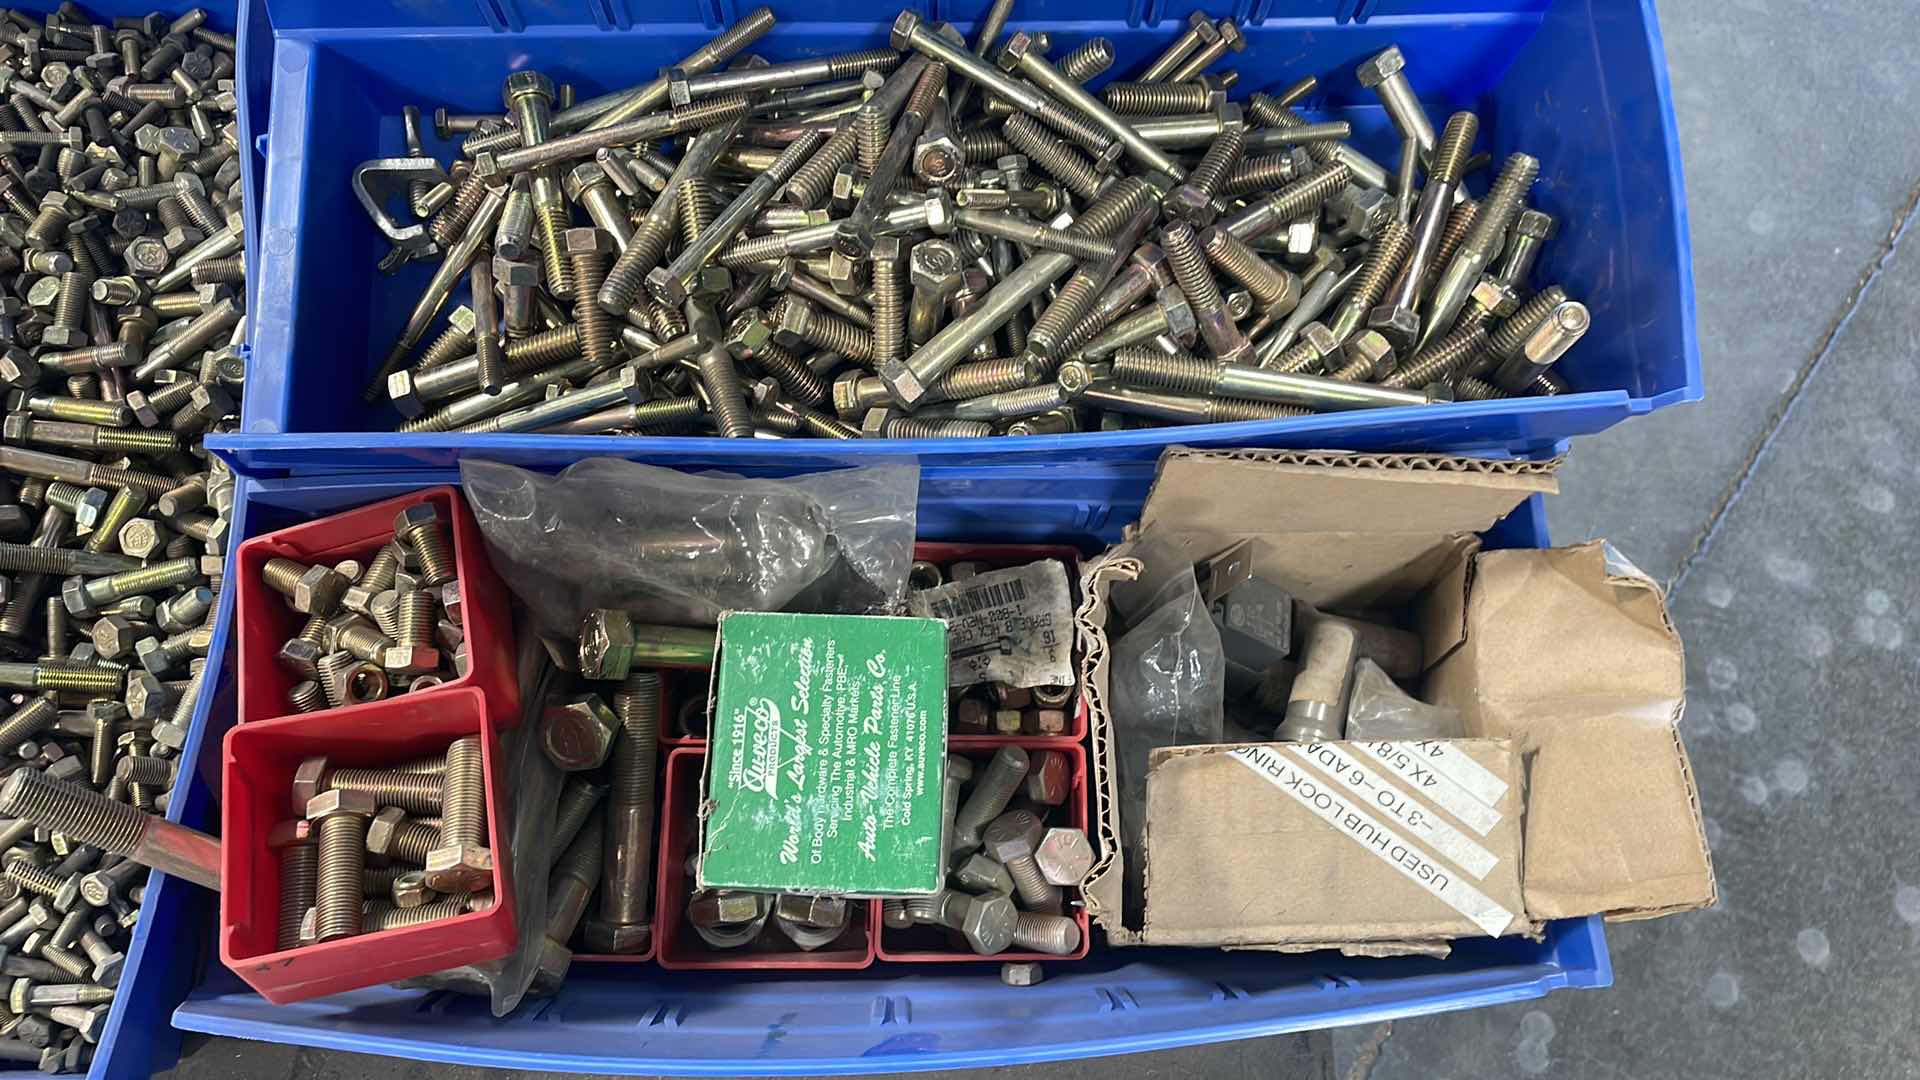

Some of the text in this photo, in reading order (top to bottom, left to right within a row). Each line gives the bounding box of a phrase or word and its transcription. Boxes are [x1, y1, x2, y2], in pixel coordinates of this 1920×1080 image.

[821, 640, 836, 692] Fasteners
[866, 650, 886, 678] Co.
[818, 695, 834, 744] Specialty
[905, 712, 916, 742] 41076
[768, 720, 778, 776] PRODUCTS
[780, 637, 813, 864] World's Largest Selection
[818, 748, 828, 756] &
[846, 727, 858, 754] MRO
[883, 675, 902, 830] The Complete Fastener Line
[904, 746, 914, 761] KY
[916, 710, 927, 796] www.auveco.com
[1296, 742, 1350, 773] ADA
[830, 761, 841, 782] The
[845, 758, 856, 766] &
[1376, 742, 1438, 788] 4X 5/8
[841, 770, 855, 821] Industrial
[903, 763, 915, 800] Spring,
[1282, 771, 1344, 818] LOCK
[826, 786, 842, 838] Servcing
[902, 802, 912, 826] Cold
[1377, 790, 1405, 817] TO
[812, 818, 826, 847] Body
[1343, 813, 1390, 851] HUB
[811, 850, 822, 864] Of
[1391, 845, 1449, 892] USED
